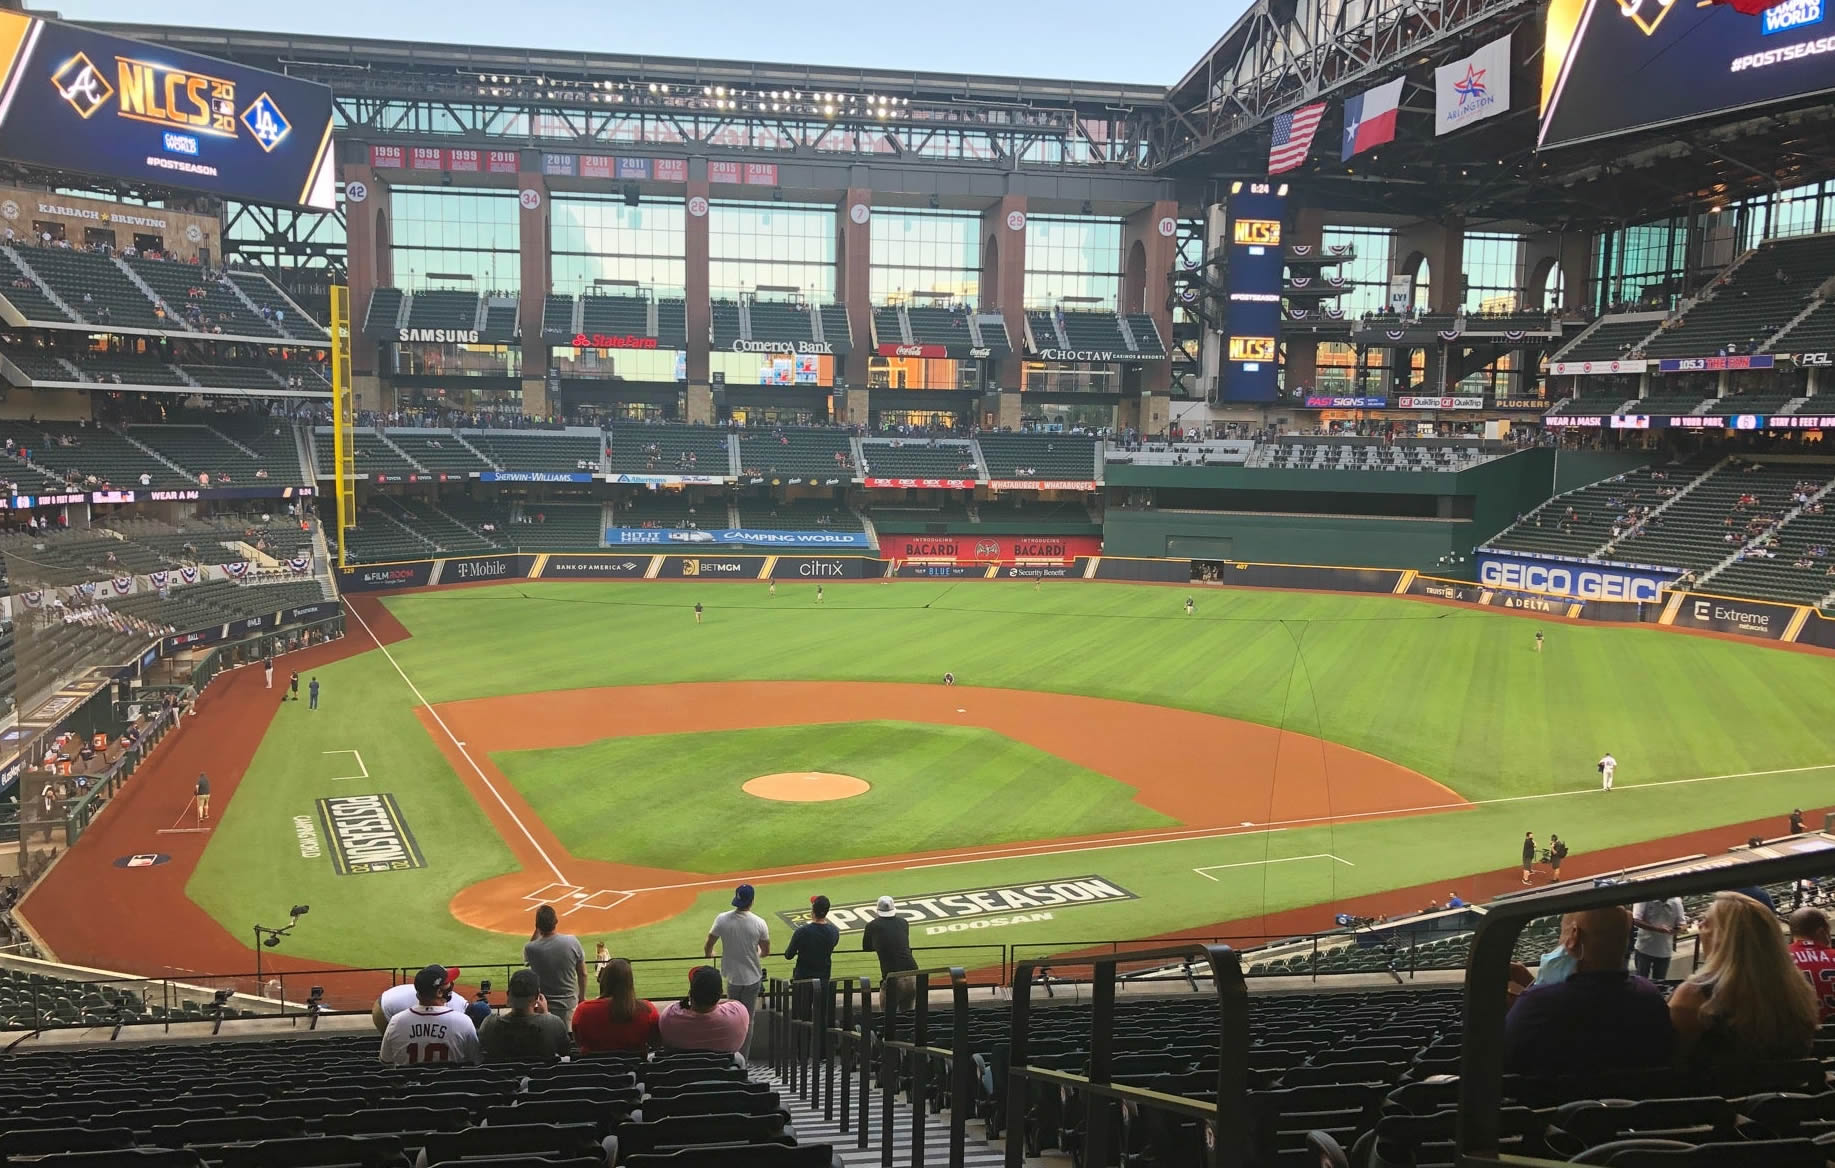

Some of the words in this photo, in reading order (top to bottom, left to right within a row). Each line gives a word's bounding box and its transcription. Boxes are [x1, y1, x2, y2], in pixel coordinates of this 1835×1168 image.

[1766, 8, 1819, 30] WORLD
[118, 61, 210, 126] NLCS
[211, 82, 234, 100] 20
[1447, 96, 1494, 120] ARLINGTON
[213, 114, 236, 132] 20
[165, 139, 197, 153] WORLD
[375, 146, 400, 157] 1996
[414, 148, 440, 159] 1998
[451, 150, 477, 160] 1999
[490, 152, 515, 162] 2010
[146, 156, 218, 176] #POSTSEASON
[547, 155, 571, 165] 2010
[586, 156, 608, 167] 2011
[622, 157, 644, 168] 2011
[658, 159, 682, 169] 2012
[712, 162, 736, 173] 2015
[749, 164, 773, 174] 2016
[349, 186, 364, 198] 42
[522, 194, 538, 205] 34
[691, 201, 705, 212] 26
[38, 204, 99, 220] KARBACH
[110, 214, 167, 229] BREWING
[856, 208, 864, 220] 7
[1008, 215, 1023, 226] 29
[1161, 220, 1173, 233] 10
[1234, 222, 1270, 242] NLCS
[400, 329, 479, 343] SAMSUNG
[799, 341, 833, 353] Bank
[1229, 339, 1265, 359] NLCS
[1047, 349, 1112, 361] CHOCTAW
[1803, 352, 1832, 364] PGL
[1679, 360, 1704, 369] 105.3
[1706, 357, 1725, 368] THE
[1413, 398, 1440, 407] QuikTrip
[1454, 399, 1481, 408] QuikTrip
[1496, 399, 1550, 408] PLUCKERS
[1546, 417, 1568, 426] WEAR
[1569, 417, 1577, 426] A
[1577, 417, 1601, 426] MASK
[1770, 418, 1790, 427] STAY
[1799, 418, 1818, 427] FEET
[992, 481, 1040, 489] WHATABURGER
[1044, 481, 1094, 490] WHATABURGER
[151, 492, 178, 500] WEAR
[179, 491, 186, 499] A
[723, 531, 795, 543] CAMPING
[797, 533, 854, 543] WORLD
[700, 564, 740, 572] BETMGM
[800, 560, 843, 576] citrix
[929, 567, 950, 575] BLUE
[1018, 568, 1043, 577] Security
[1044, 568, 1065, 576] Benefit
[1481, 560, 1572, 596] GEICO
[1426, 587, 1445, 596] TRUIST
[1516, 599, 1550, 612] DELTA
[1715, 607, 1770, 625] Extreme
[1738, 623, 1768, 633] networks
[328, 795, 407, 864] POSTSEASON
[926, 912, 1054, 936] DOOSAN
[409, 1023, 448, 1039] JONES
